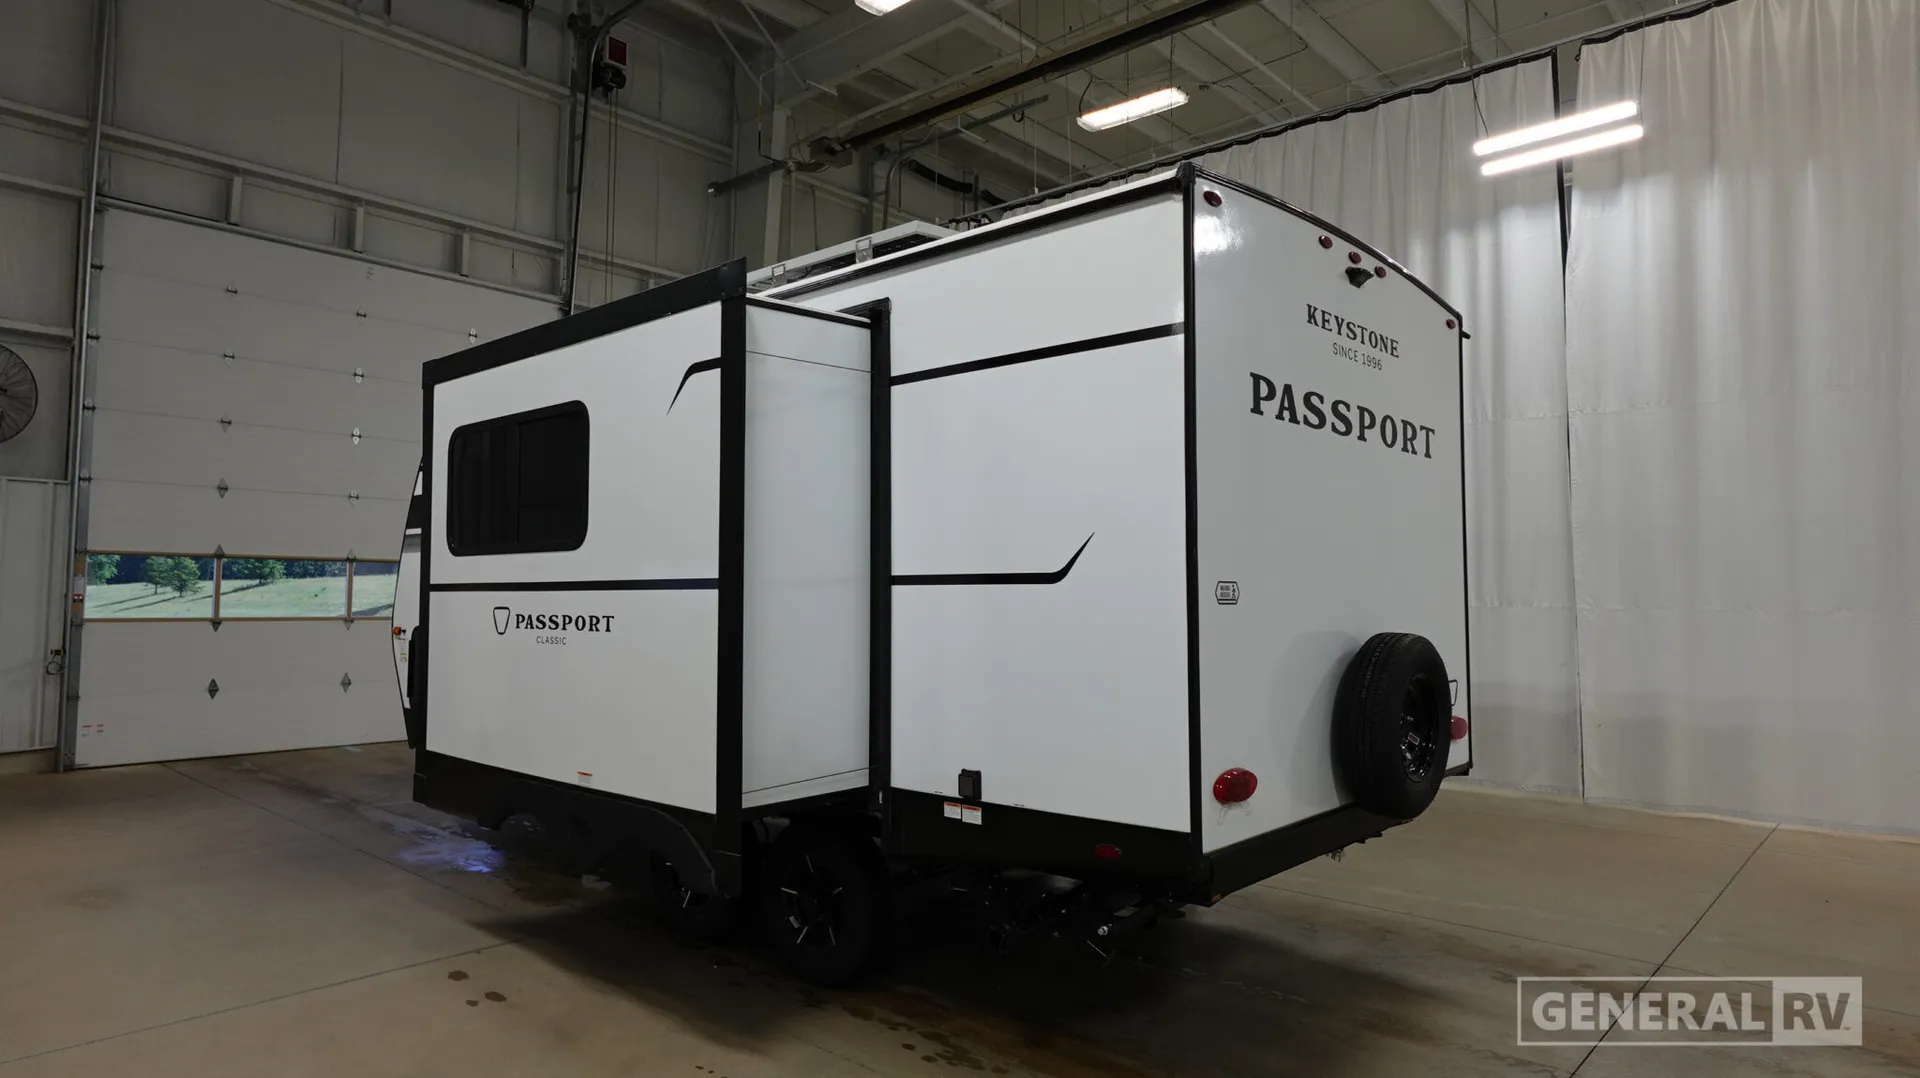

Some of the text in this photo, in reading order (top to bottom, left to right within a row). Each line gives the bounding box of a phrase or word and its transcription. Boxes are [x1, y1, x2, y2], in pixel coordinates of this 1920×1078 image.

[1306, 303, 1400, 358] KEYSTONE
[1332, 342, 1383, 371] SINCE 1996
[1249, 372, 1436, 459] PASSPORT
[515, 613, 615, 633] PASSPORT
[536, 635, 567, 645] CLASSIC
